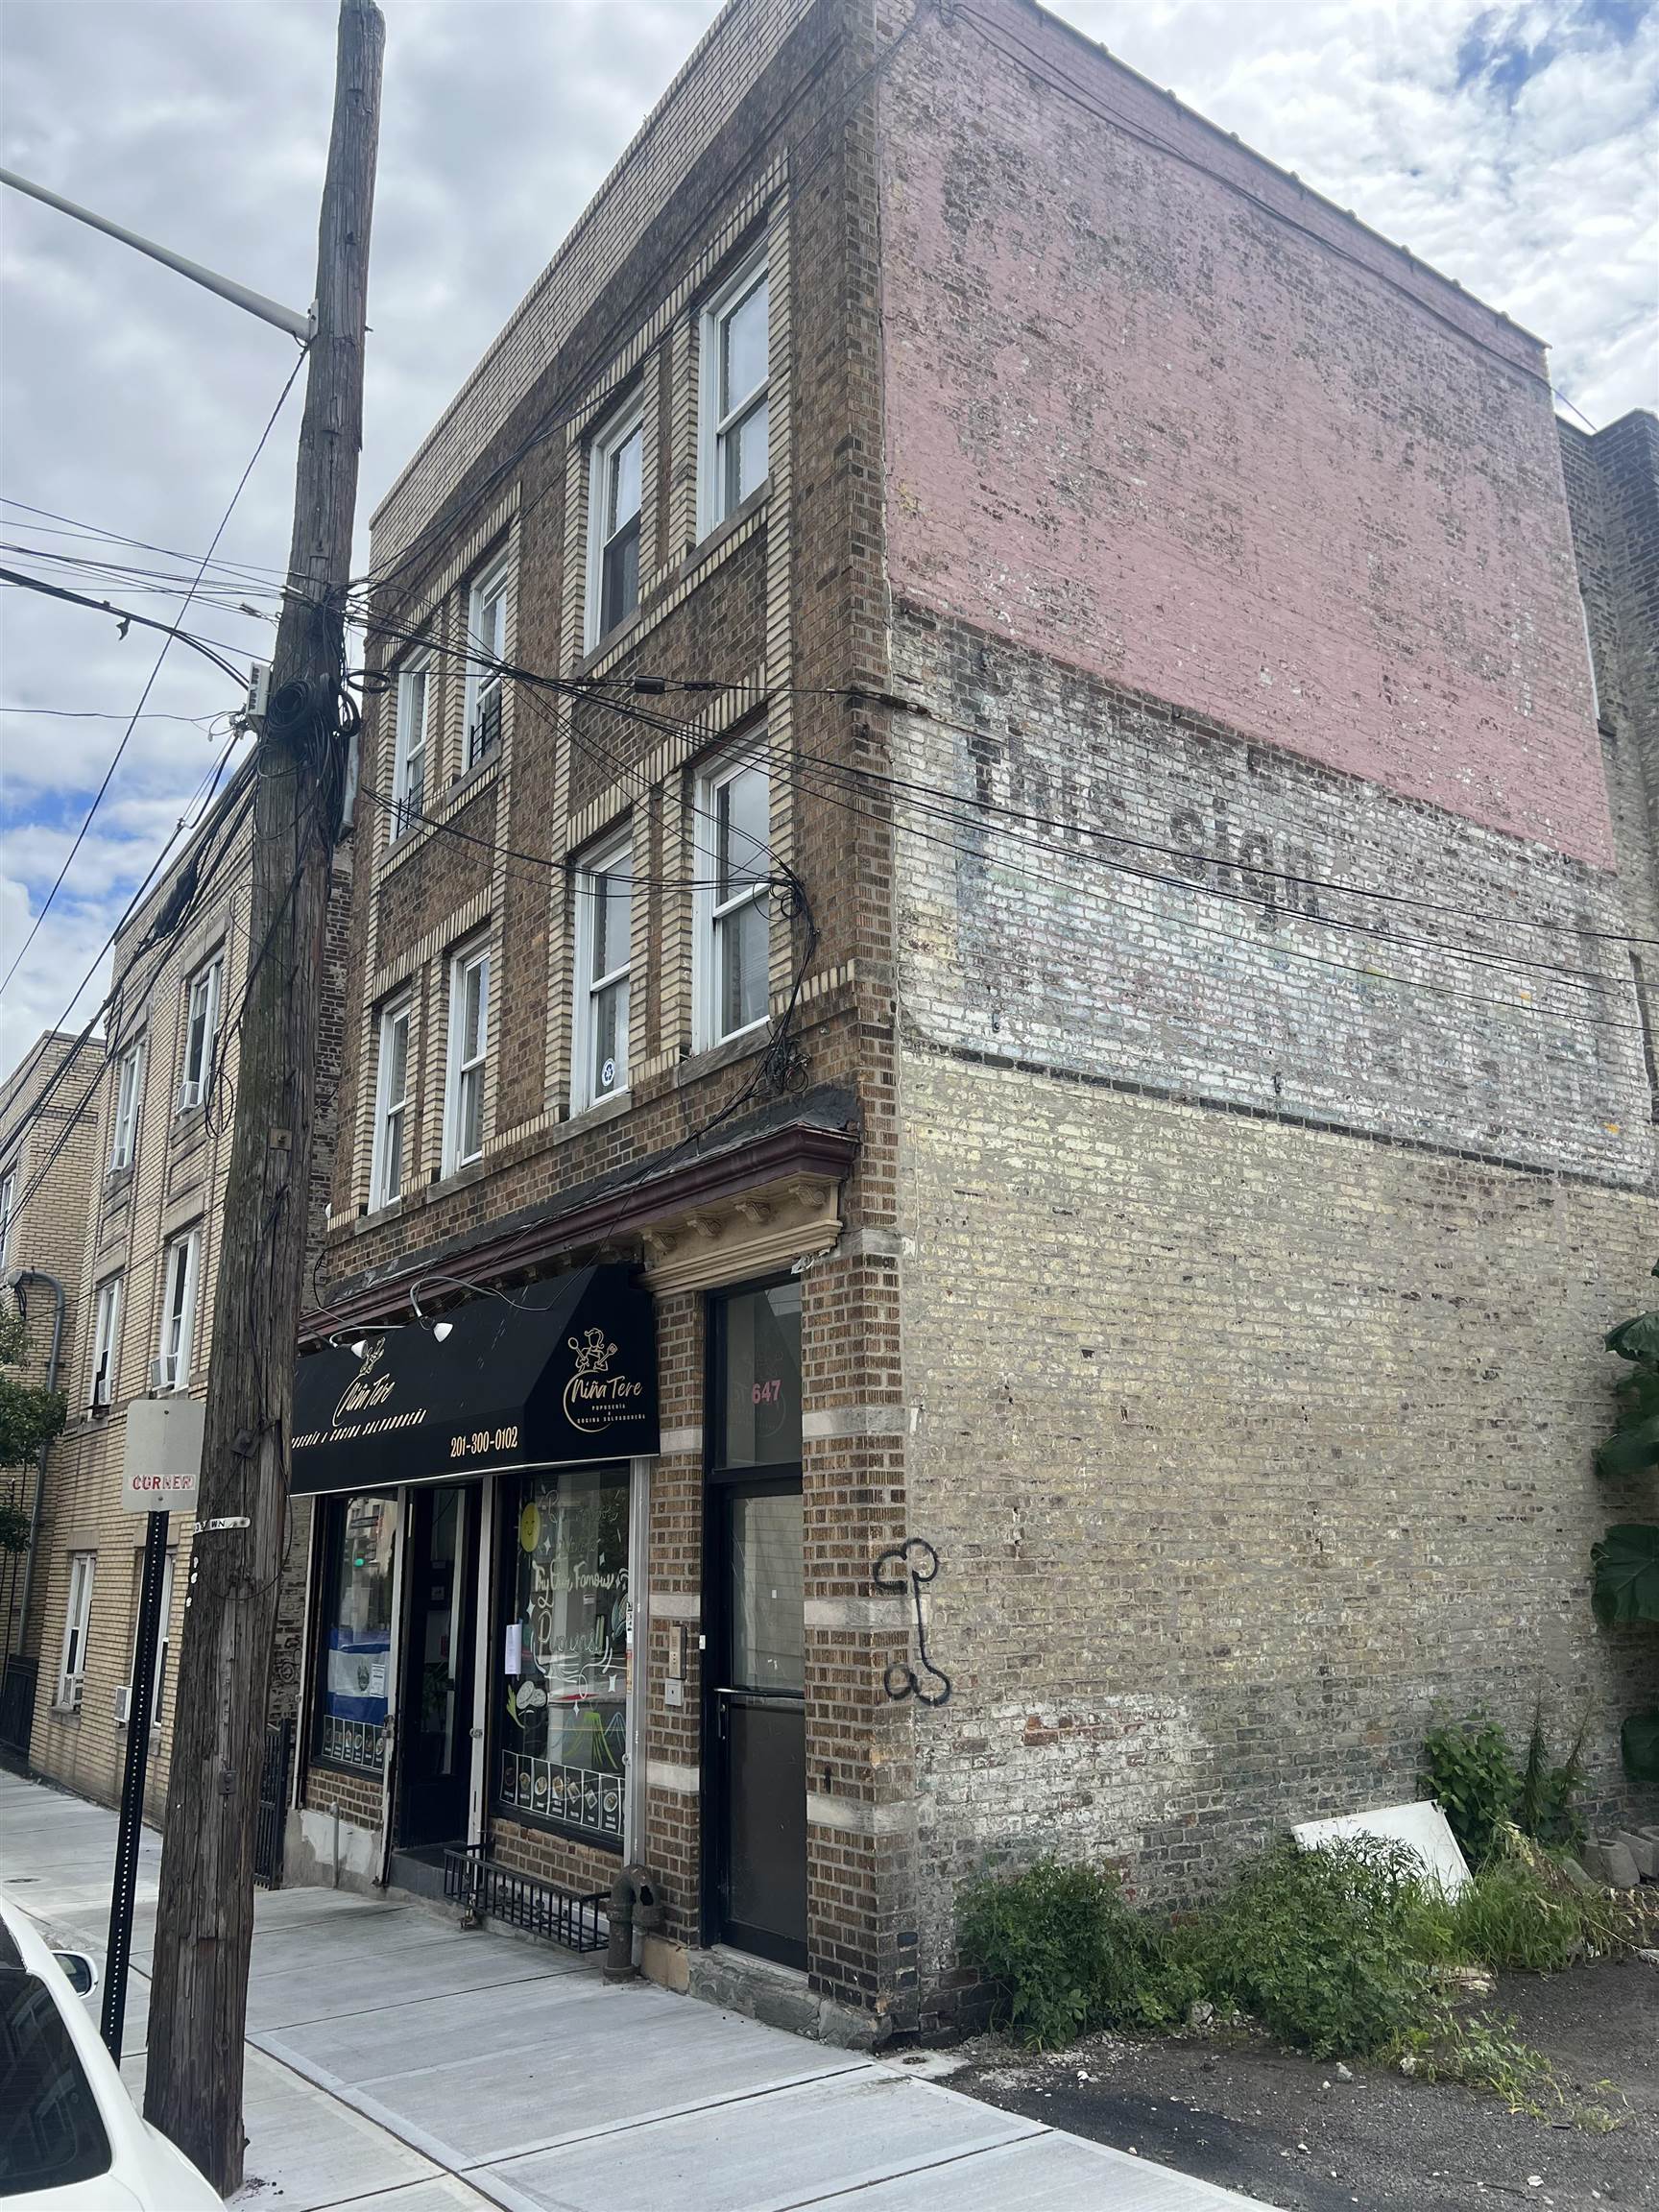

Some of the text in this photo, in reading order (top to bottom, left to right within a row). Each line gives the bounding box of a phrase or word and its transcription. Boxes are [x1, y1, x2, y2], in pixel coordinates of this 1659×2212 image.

[364, 1373, 396, 1410] Tere
[571, 1375, 643, 1404] Niña Tere
[752, 1379, 782, 1405] 647
[450, 1426, 518, 1458] 201-300-0102
[132, 1475, 192, 1490] CORNER
[532, 1559, 554, 1608] Try
[573, 1560, 614, 1591] Famous
